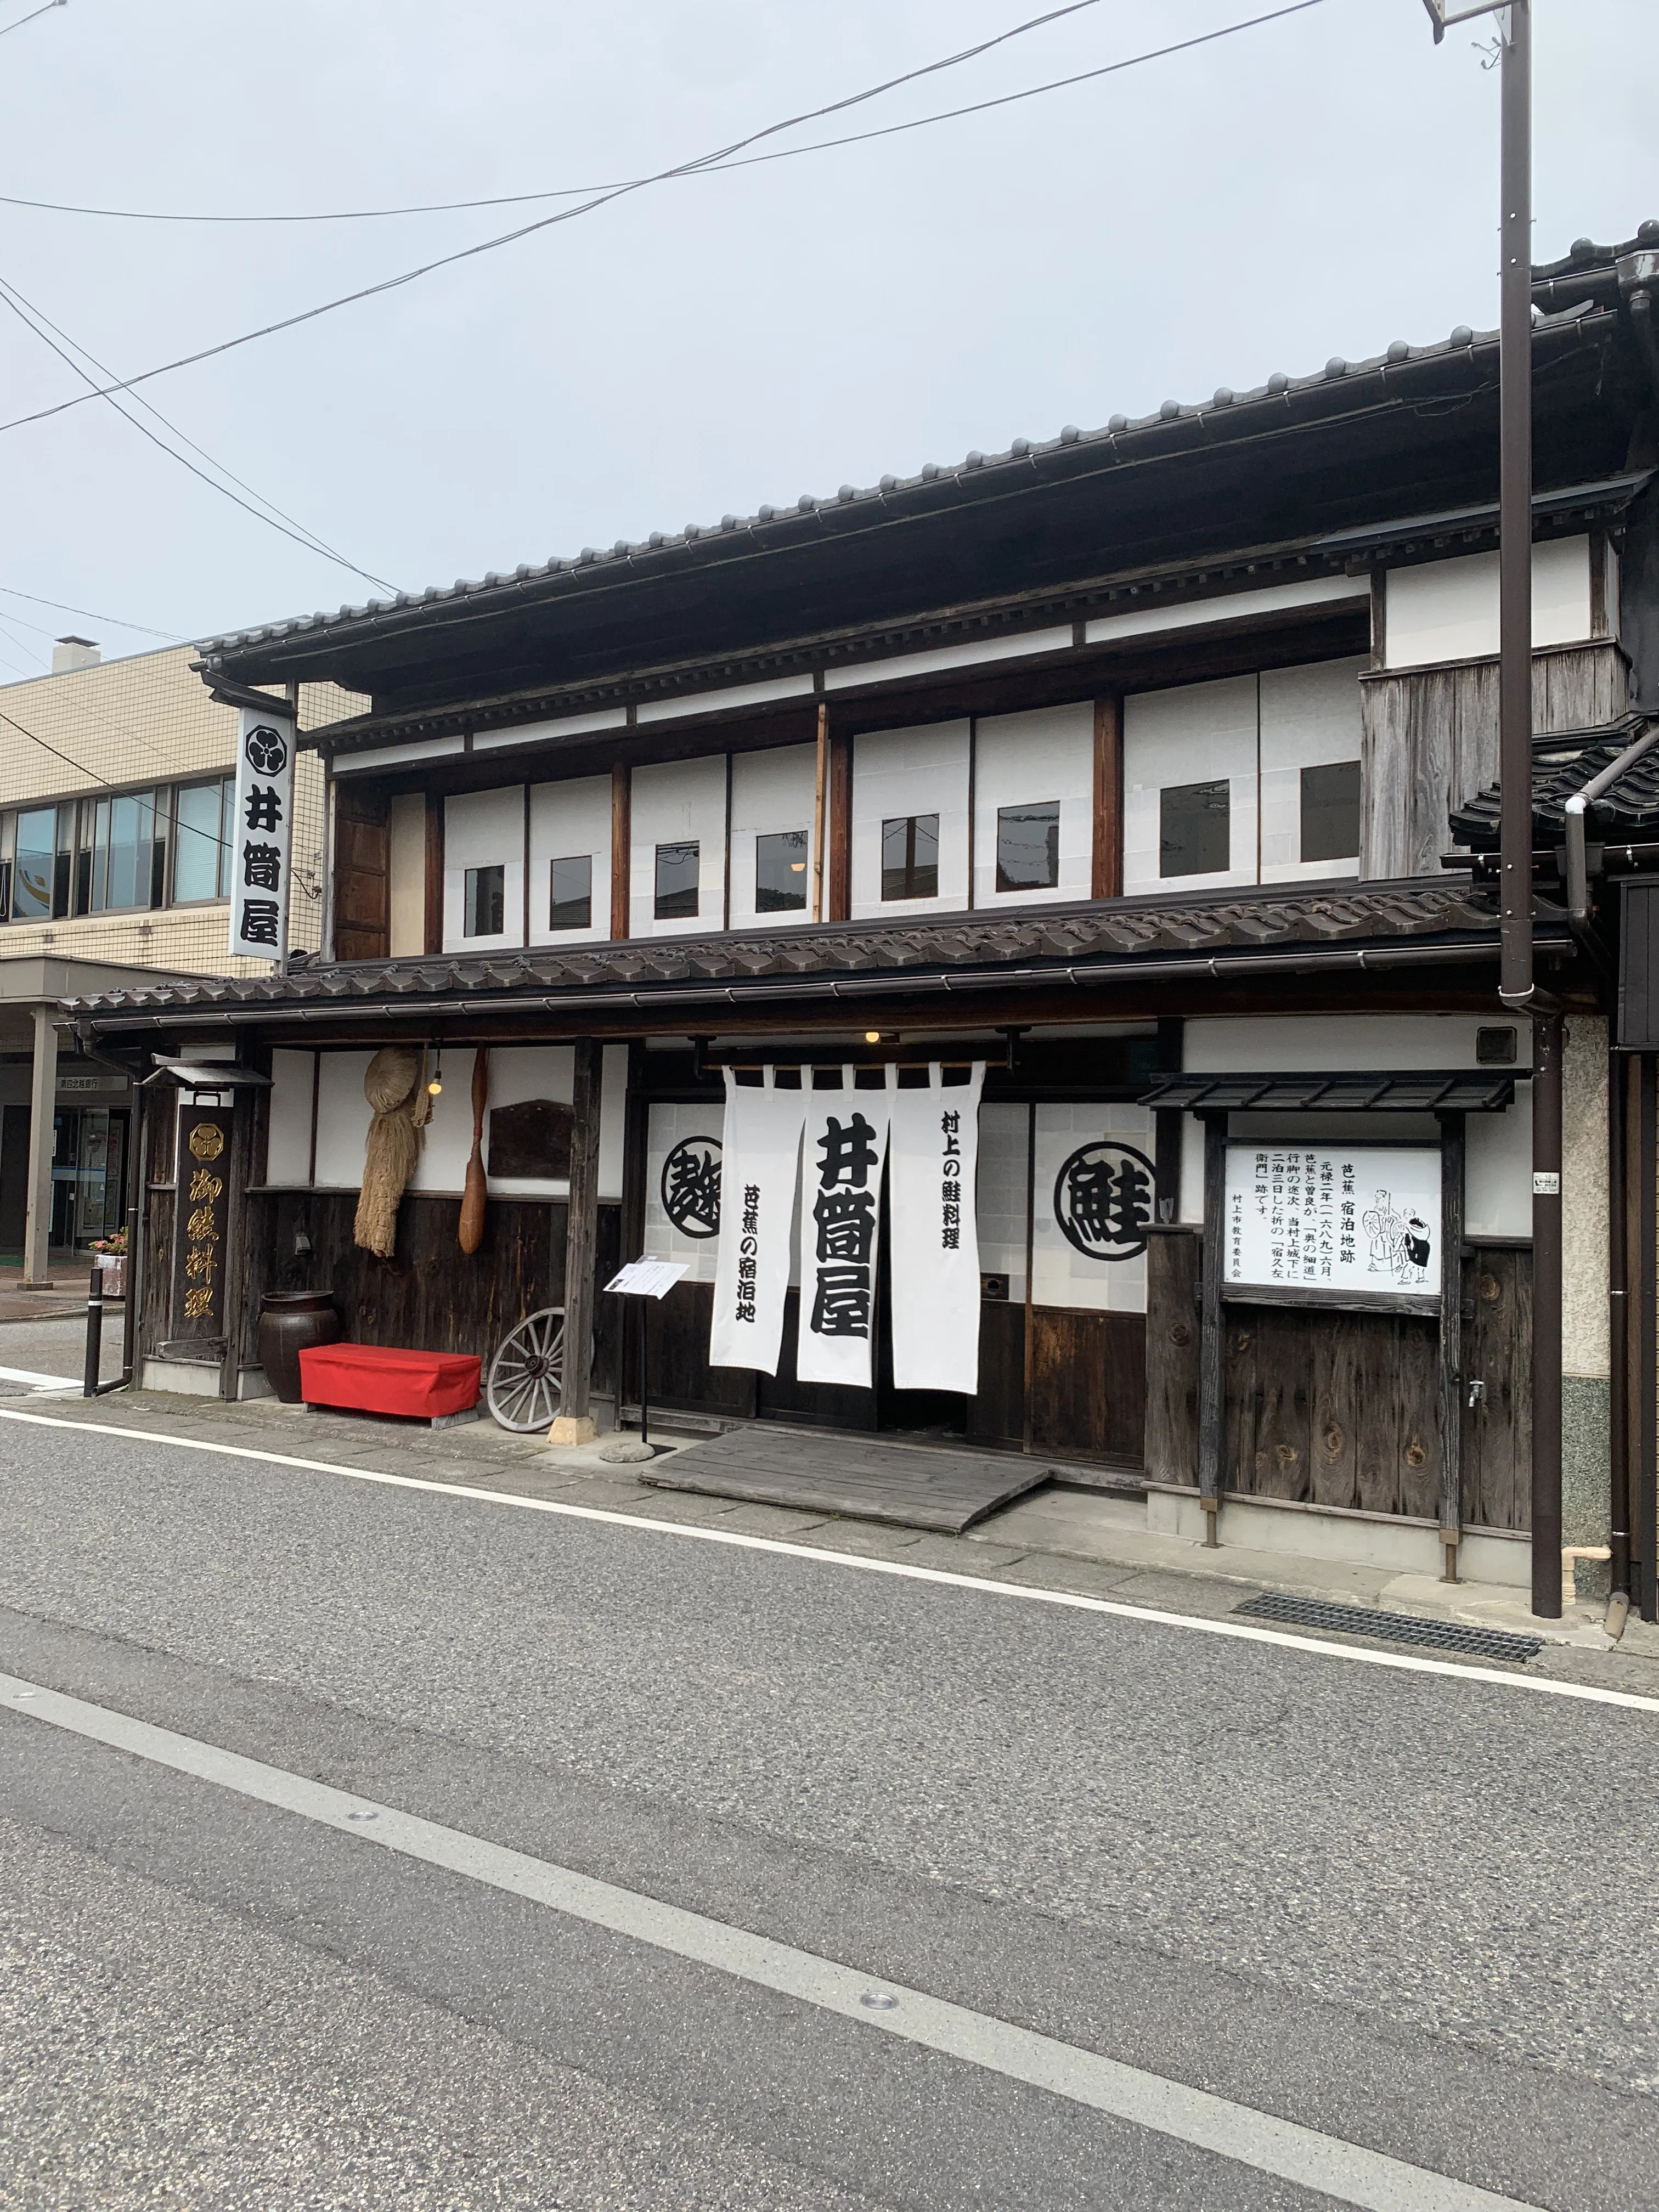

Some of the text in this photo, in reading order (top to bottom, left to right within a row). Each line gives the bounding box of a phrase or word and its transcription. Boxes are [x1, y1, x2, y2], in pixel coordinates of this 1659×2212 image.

[241, 784, 283, 947] 井筒屋
[810, 1112, 878, 1340] 井筒屋
[941, 1110, 961, 1250] 村上の鮭料理
[1068, 1159, 1150, 1245] 鮭
[1232, 1194, 1243, 1278] 村上市教育委員会
[736, 1184, 760, 1323] 芭蕉の宿泊地
